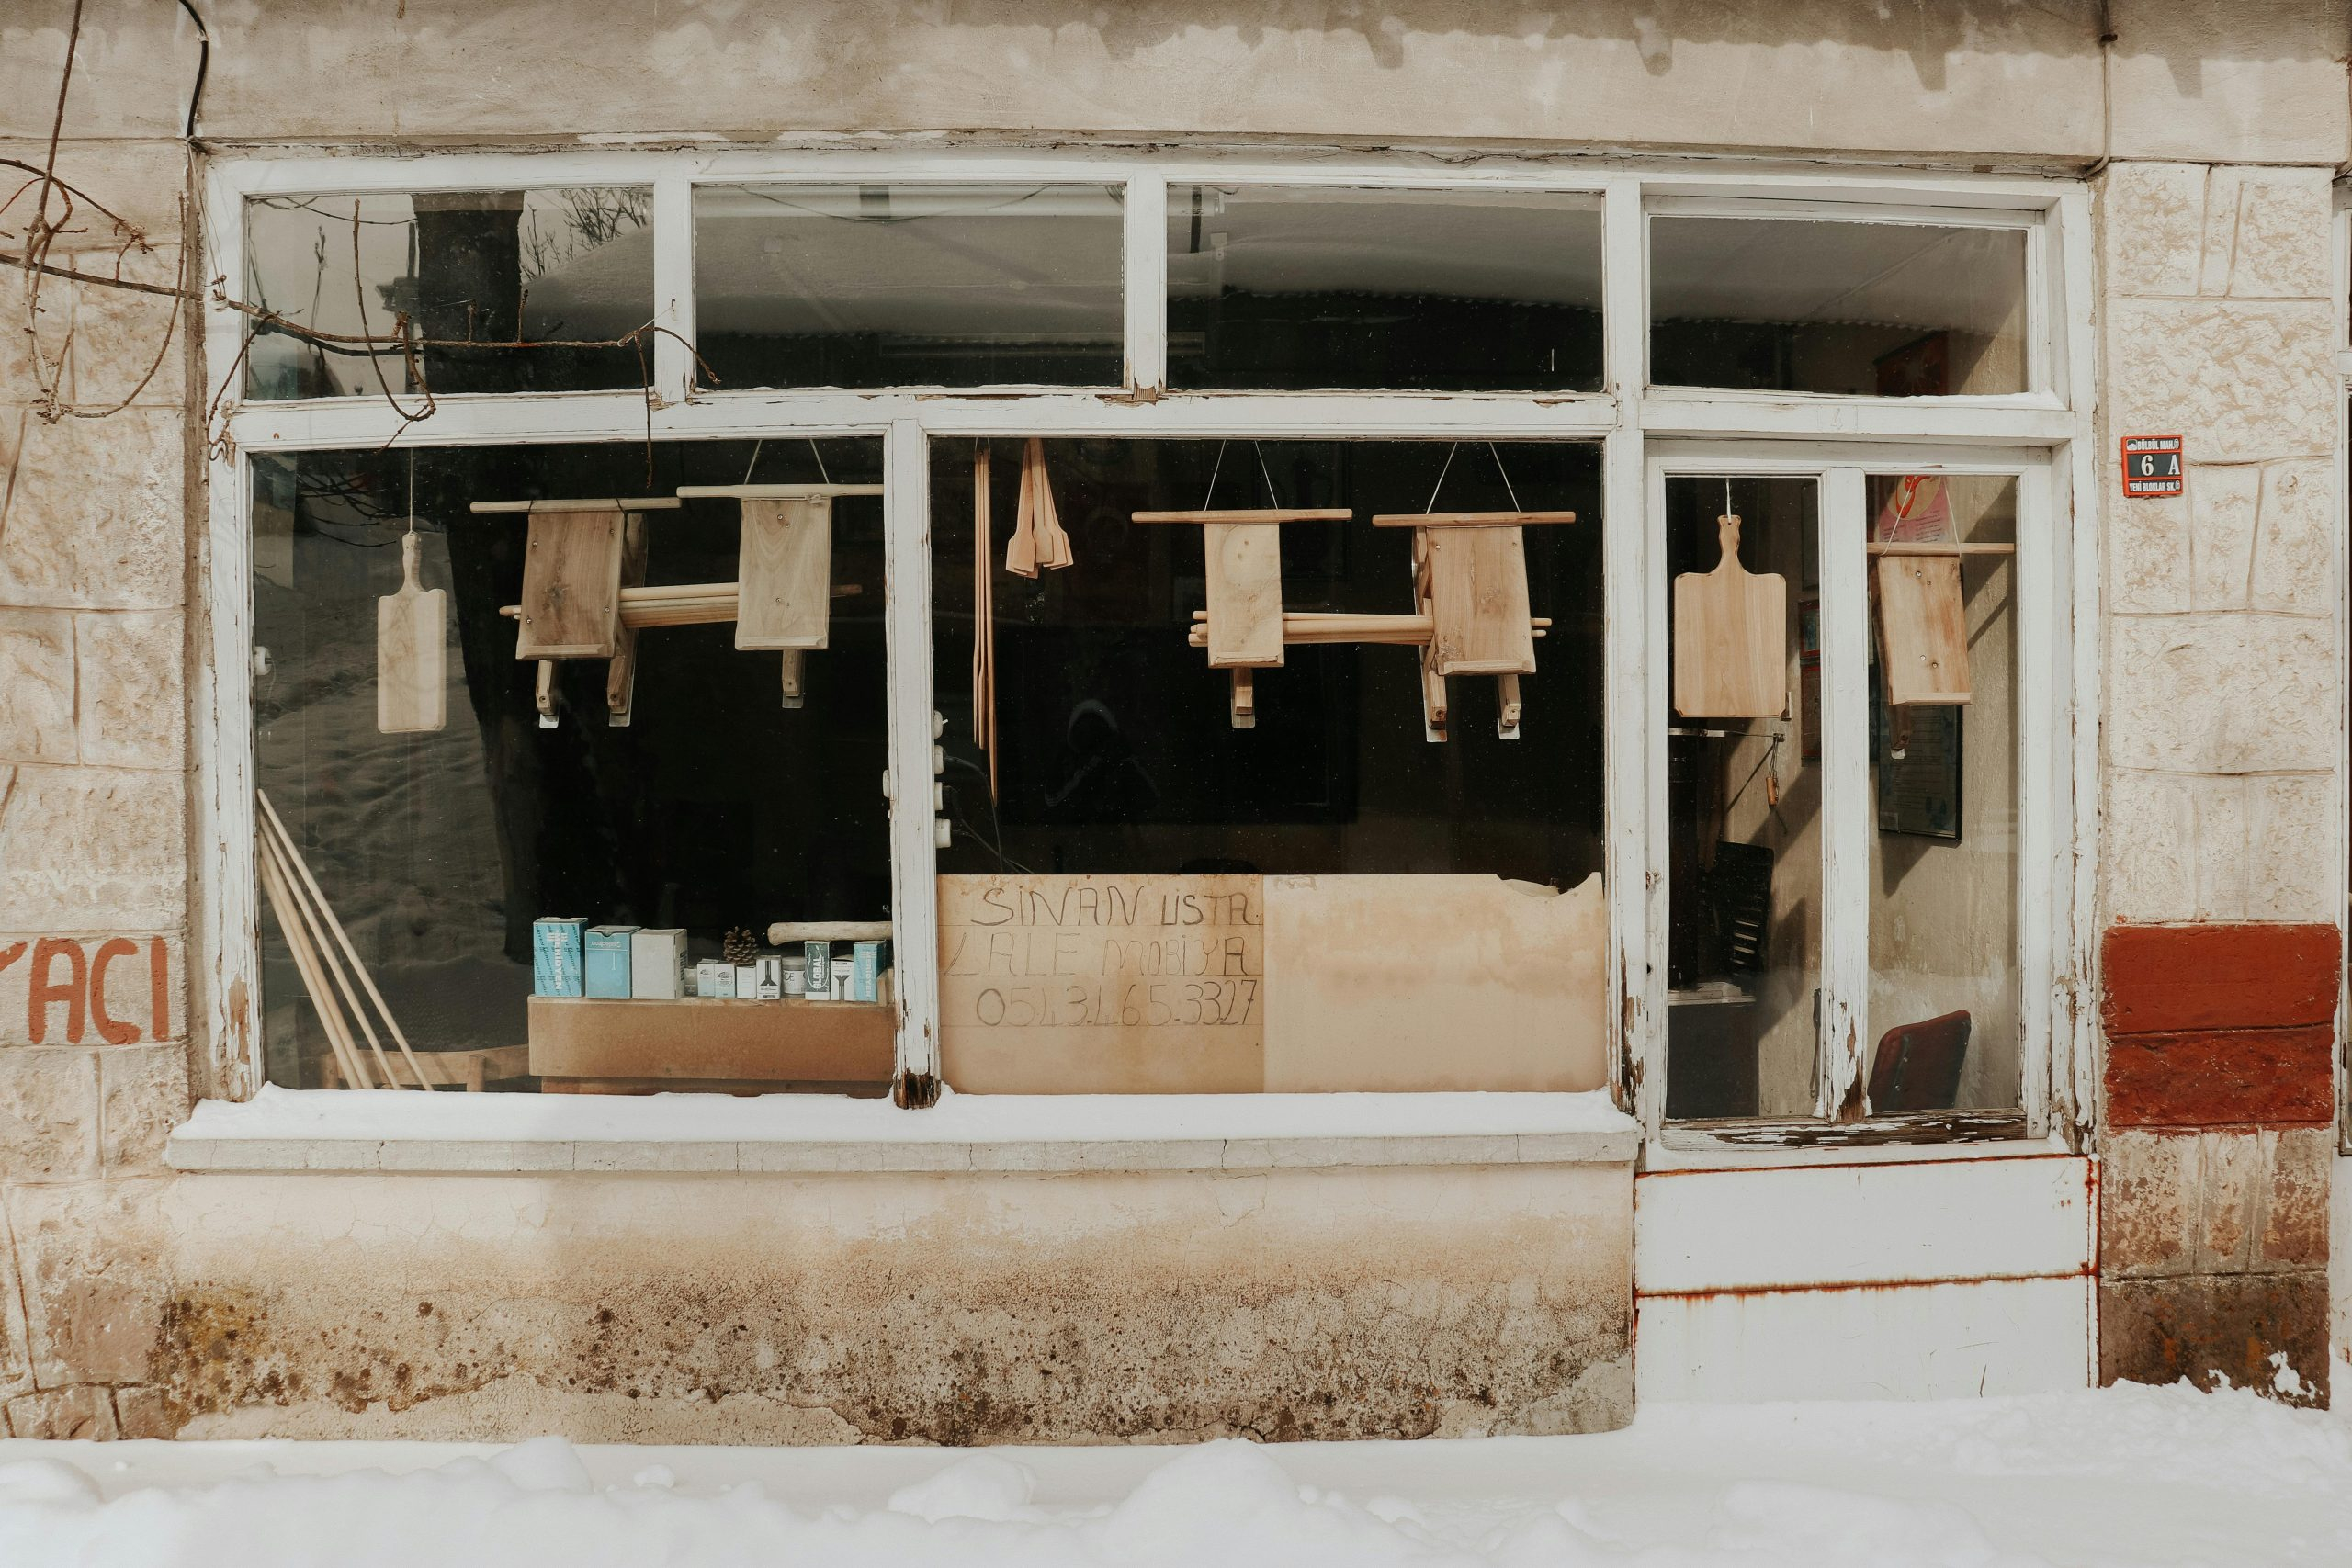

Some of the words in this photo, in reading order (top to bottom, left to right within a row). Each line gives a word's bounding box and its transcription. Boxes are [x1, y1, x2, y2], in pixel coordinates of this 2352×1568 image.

[2137, 438, 2159, 451] BÜLBÜL
[2141, 454, 2154, 476] 6
[2168, 454, 2181, 475] A
[2142, 481, 2166, 491] BLOKLAR
[944, 931, 1080, 976] LALE
